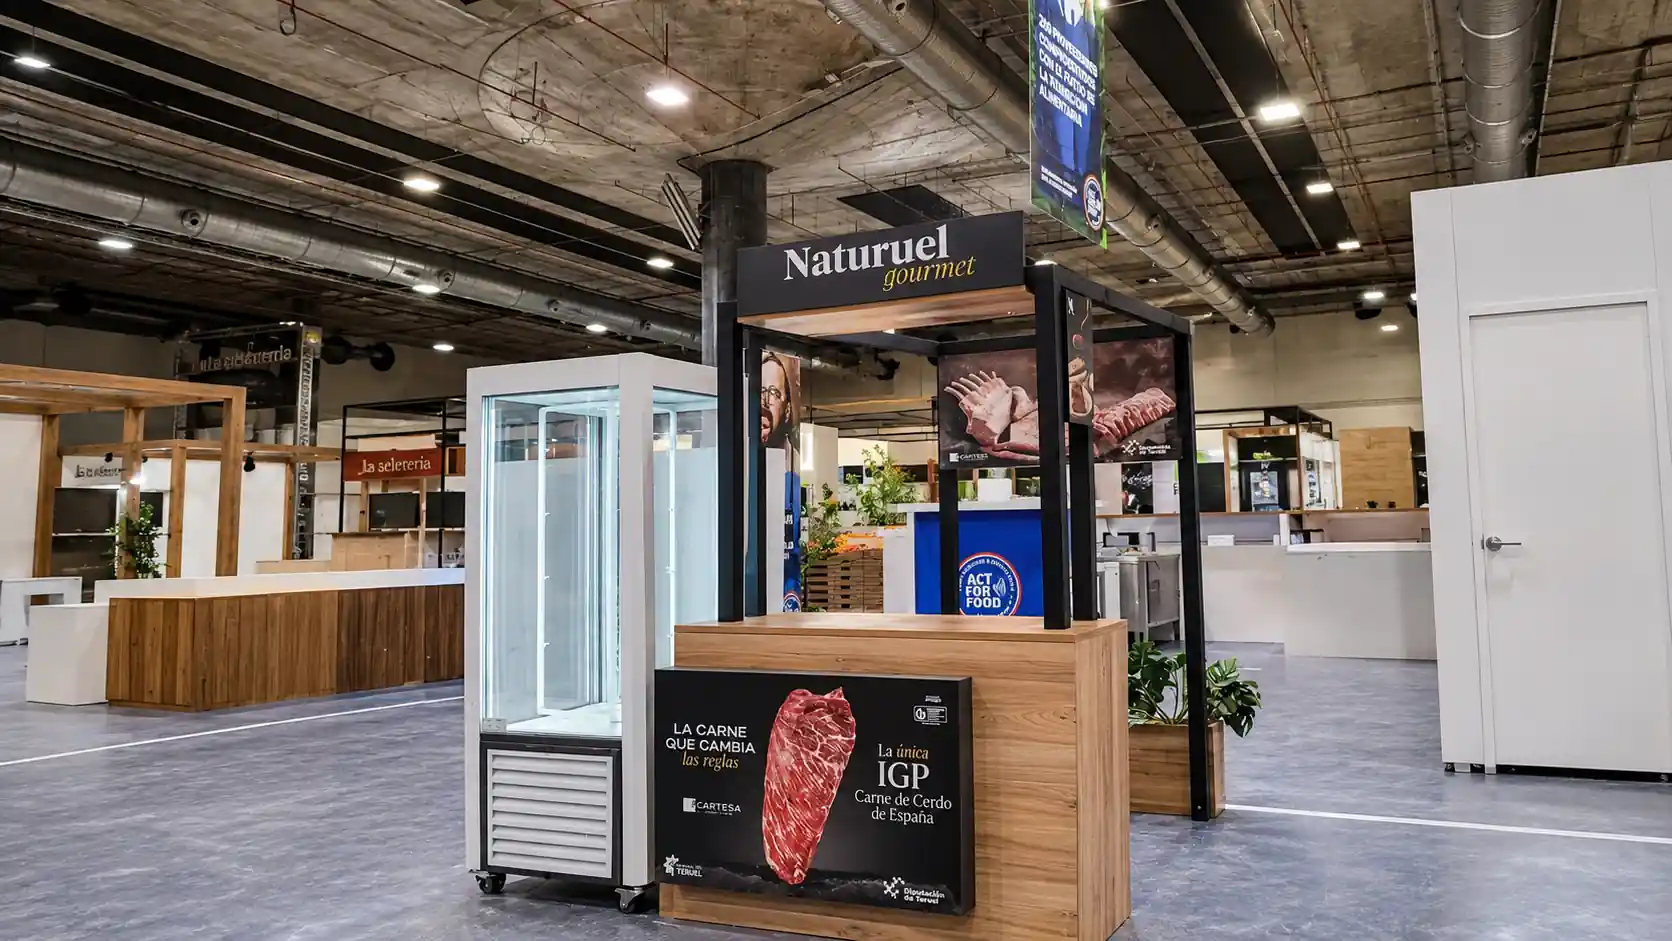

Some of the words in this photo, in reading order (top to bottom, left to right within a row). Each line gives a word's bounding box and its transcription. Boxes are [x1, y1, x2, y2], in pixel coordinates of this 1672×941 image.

[783, 224, 950, 281] Naturuel
[882, 255, 977, 292] gourmet
[967, 572, 993, 586] ACT
[965, 585, 991, 597] FOR
[966, 597, 1001, 608] FOOD
[673, 722, 692, 735] LA
[696, 724, 747, 738] CARNE
[665, 737, 696, 751] QUE
[699, 739, 756, 754] CAMBIA
[878, 743, 893, 758] La
[896, 743, 929, 760] única
[682, 750, 699, 767] las
[703, 753, 739, 772] reglas
[877, 760, 930, 790] IGP
[696, 801, 742, 813] CARTESA
[854, 789, 892, 805] Carne
[894, 792, 910, 807] de
[912, 793, 952, 810] Cerdo
[871, 806, 886, 821] de
[889, 807, 935, 826] España
